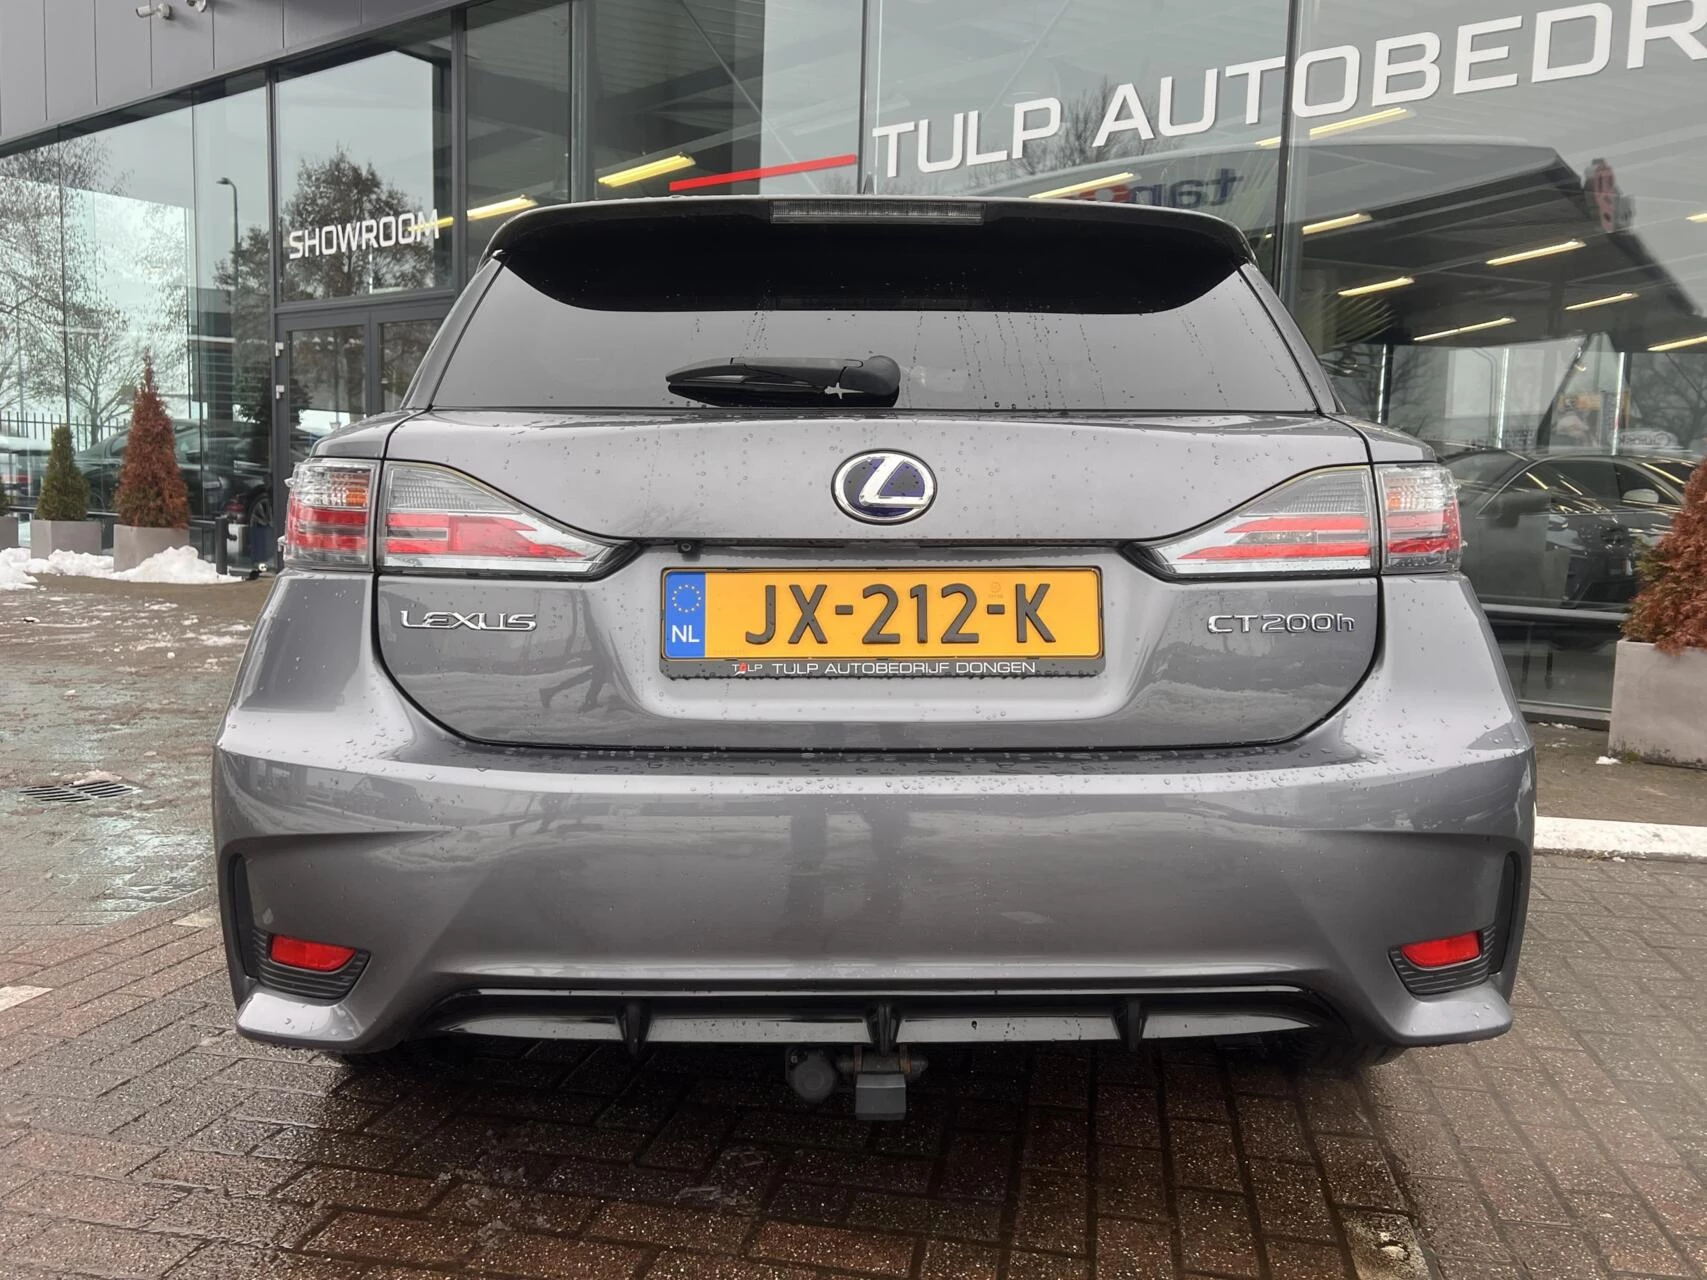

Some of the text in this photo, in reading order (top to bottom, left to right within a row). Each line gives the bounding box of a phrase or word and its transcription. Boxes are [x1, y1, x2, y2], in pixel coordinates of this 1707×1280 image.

[872, 0, 1707, 178] TULP AUTOBEDR
[289, 209, 440, 259] SHOWROOM
[400, 610, 537, 632] LEXUS
[745, 583, 1056, 645] JX-212-K
[1208, 612, 1355, 633] CT200h
[671, 624, 700, 643] NL
[772, 663, 819, 674] TULP
[824, 662, 949, 674] AUTOBEDRIJF
[956, 661, 1036, 674] DONGEN
